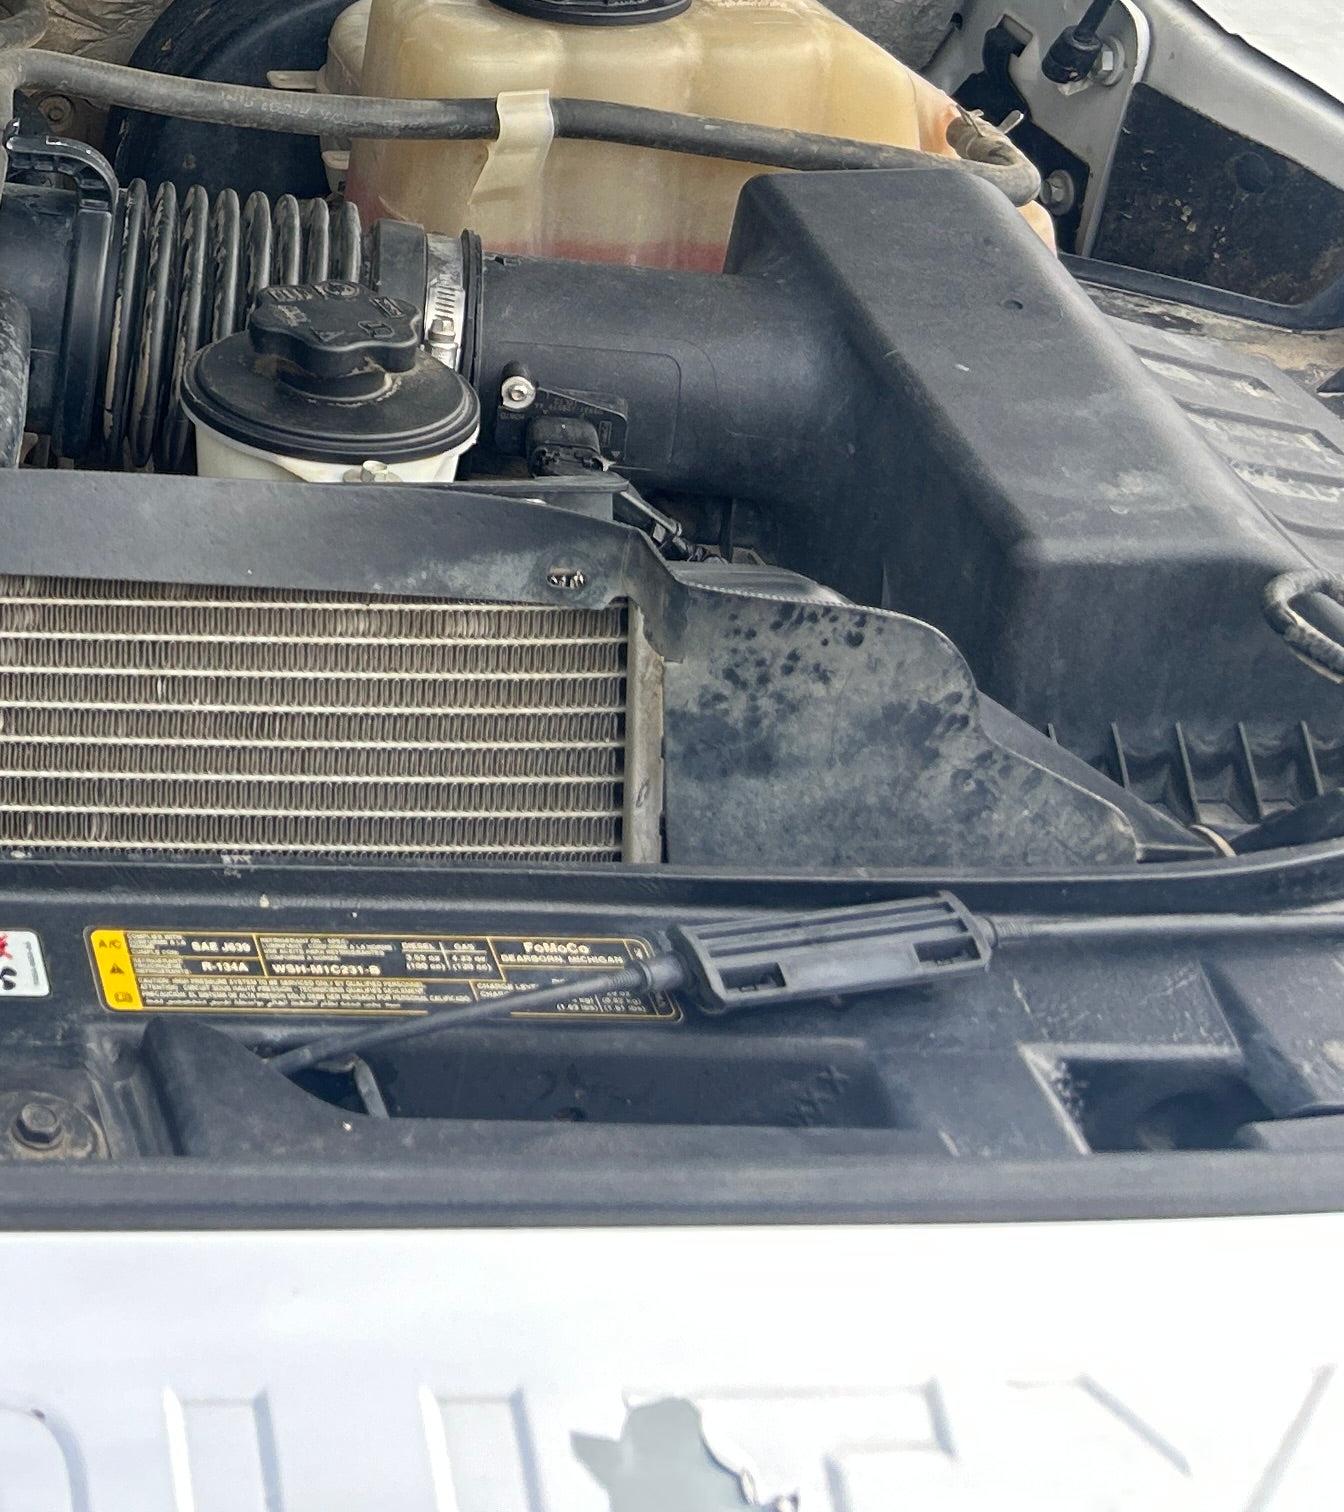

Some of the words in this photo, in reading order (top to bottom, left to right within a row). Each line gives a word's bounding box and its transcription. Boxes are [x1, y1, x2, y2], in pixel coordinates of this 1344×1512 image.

[98, 938, 122, 950] A/C
[191, 941, 218, 952] SAE
[222, 942, 251, 953] J639
[524, 942, 590, 954] FoMoCo
[568, 956, 623, 964] MICHIGAN
[201, 961, 249, 972] R-134A
